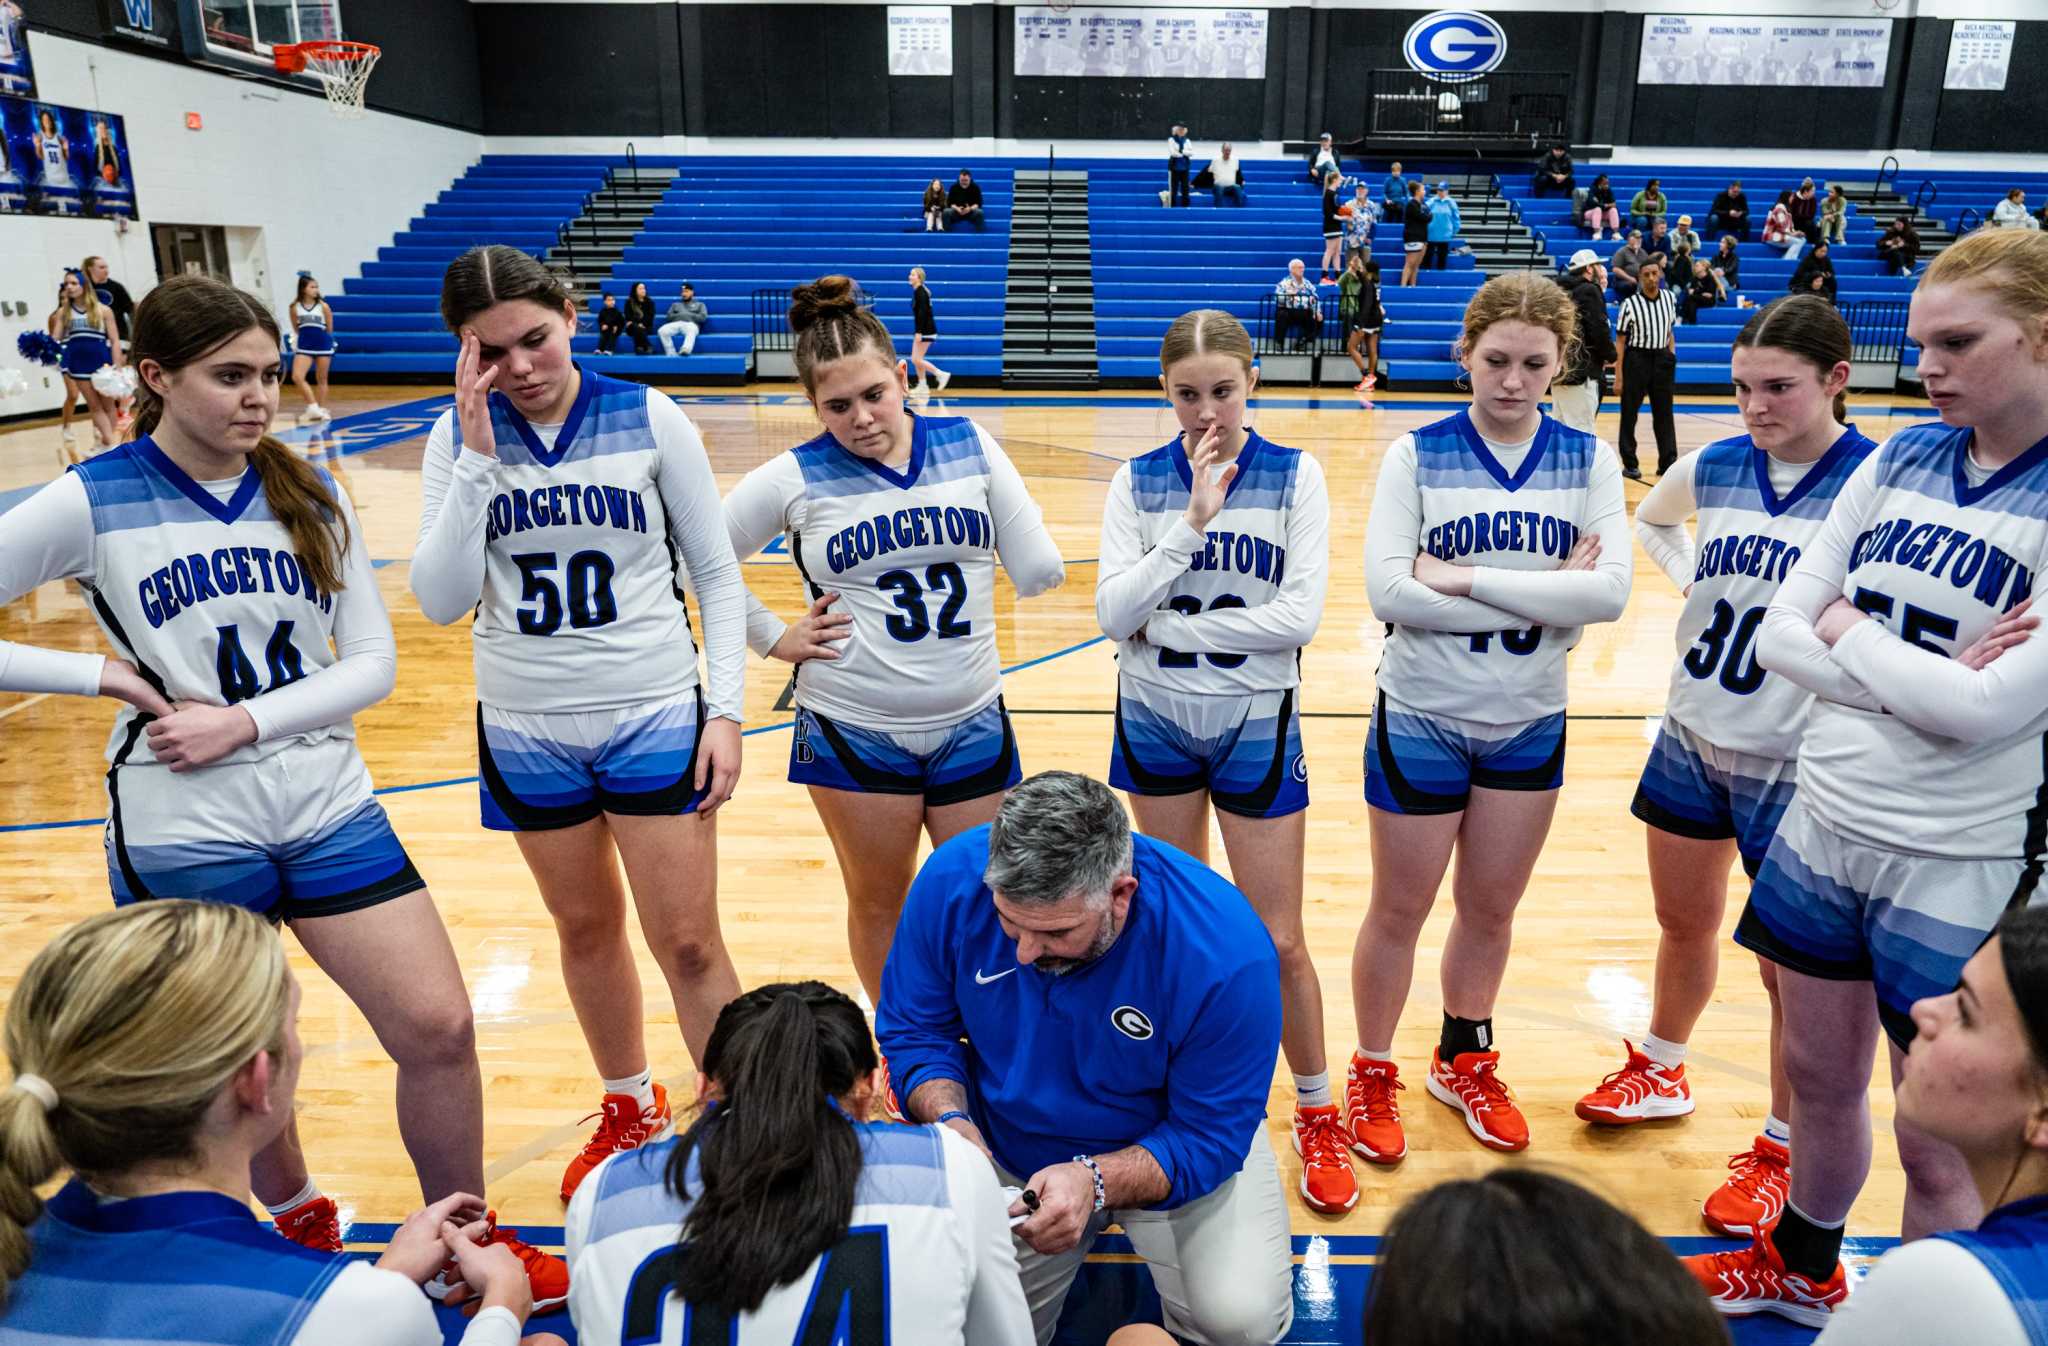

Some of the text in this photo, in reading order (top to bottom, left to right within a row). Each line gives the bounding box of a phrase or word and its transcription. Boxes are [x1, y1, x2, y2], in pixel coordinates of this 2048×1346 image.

[1047, 17, 1071, 26] CHAMPS
[1117, 18, 1142, 27] CHAMPS
[1156, 19, 1195, 27] AREA CHAMPS
[1414, 19, 1497, 72] G
[486, 484, 647, 543] EORGETOWN
[826, 506, 991, 574] GEORGETOWN
[138, 547, 332, 614] GEORGETO
[1185, 532, 1285, 588] ETOWN
[1694, 534, 1801, 584] EORGETO
[511, 550, 617, 636] 50
[875, 562, 972, 643] 32
[1683, 598, 1768, 695] 30
[1111, 1005, 1154, 1040] G
